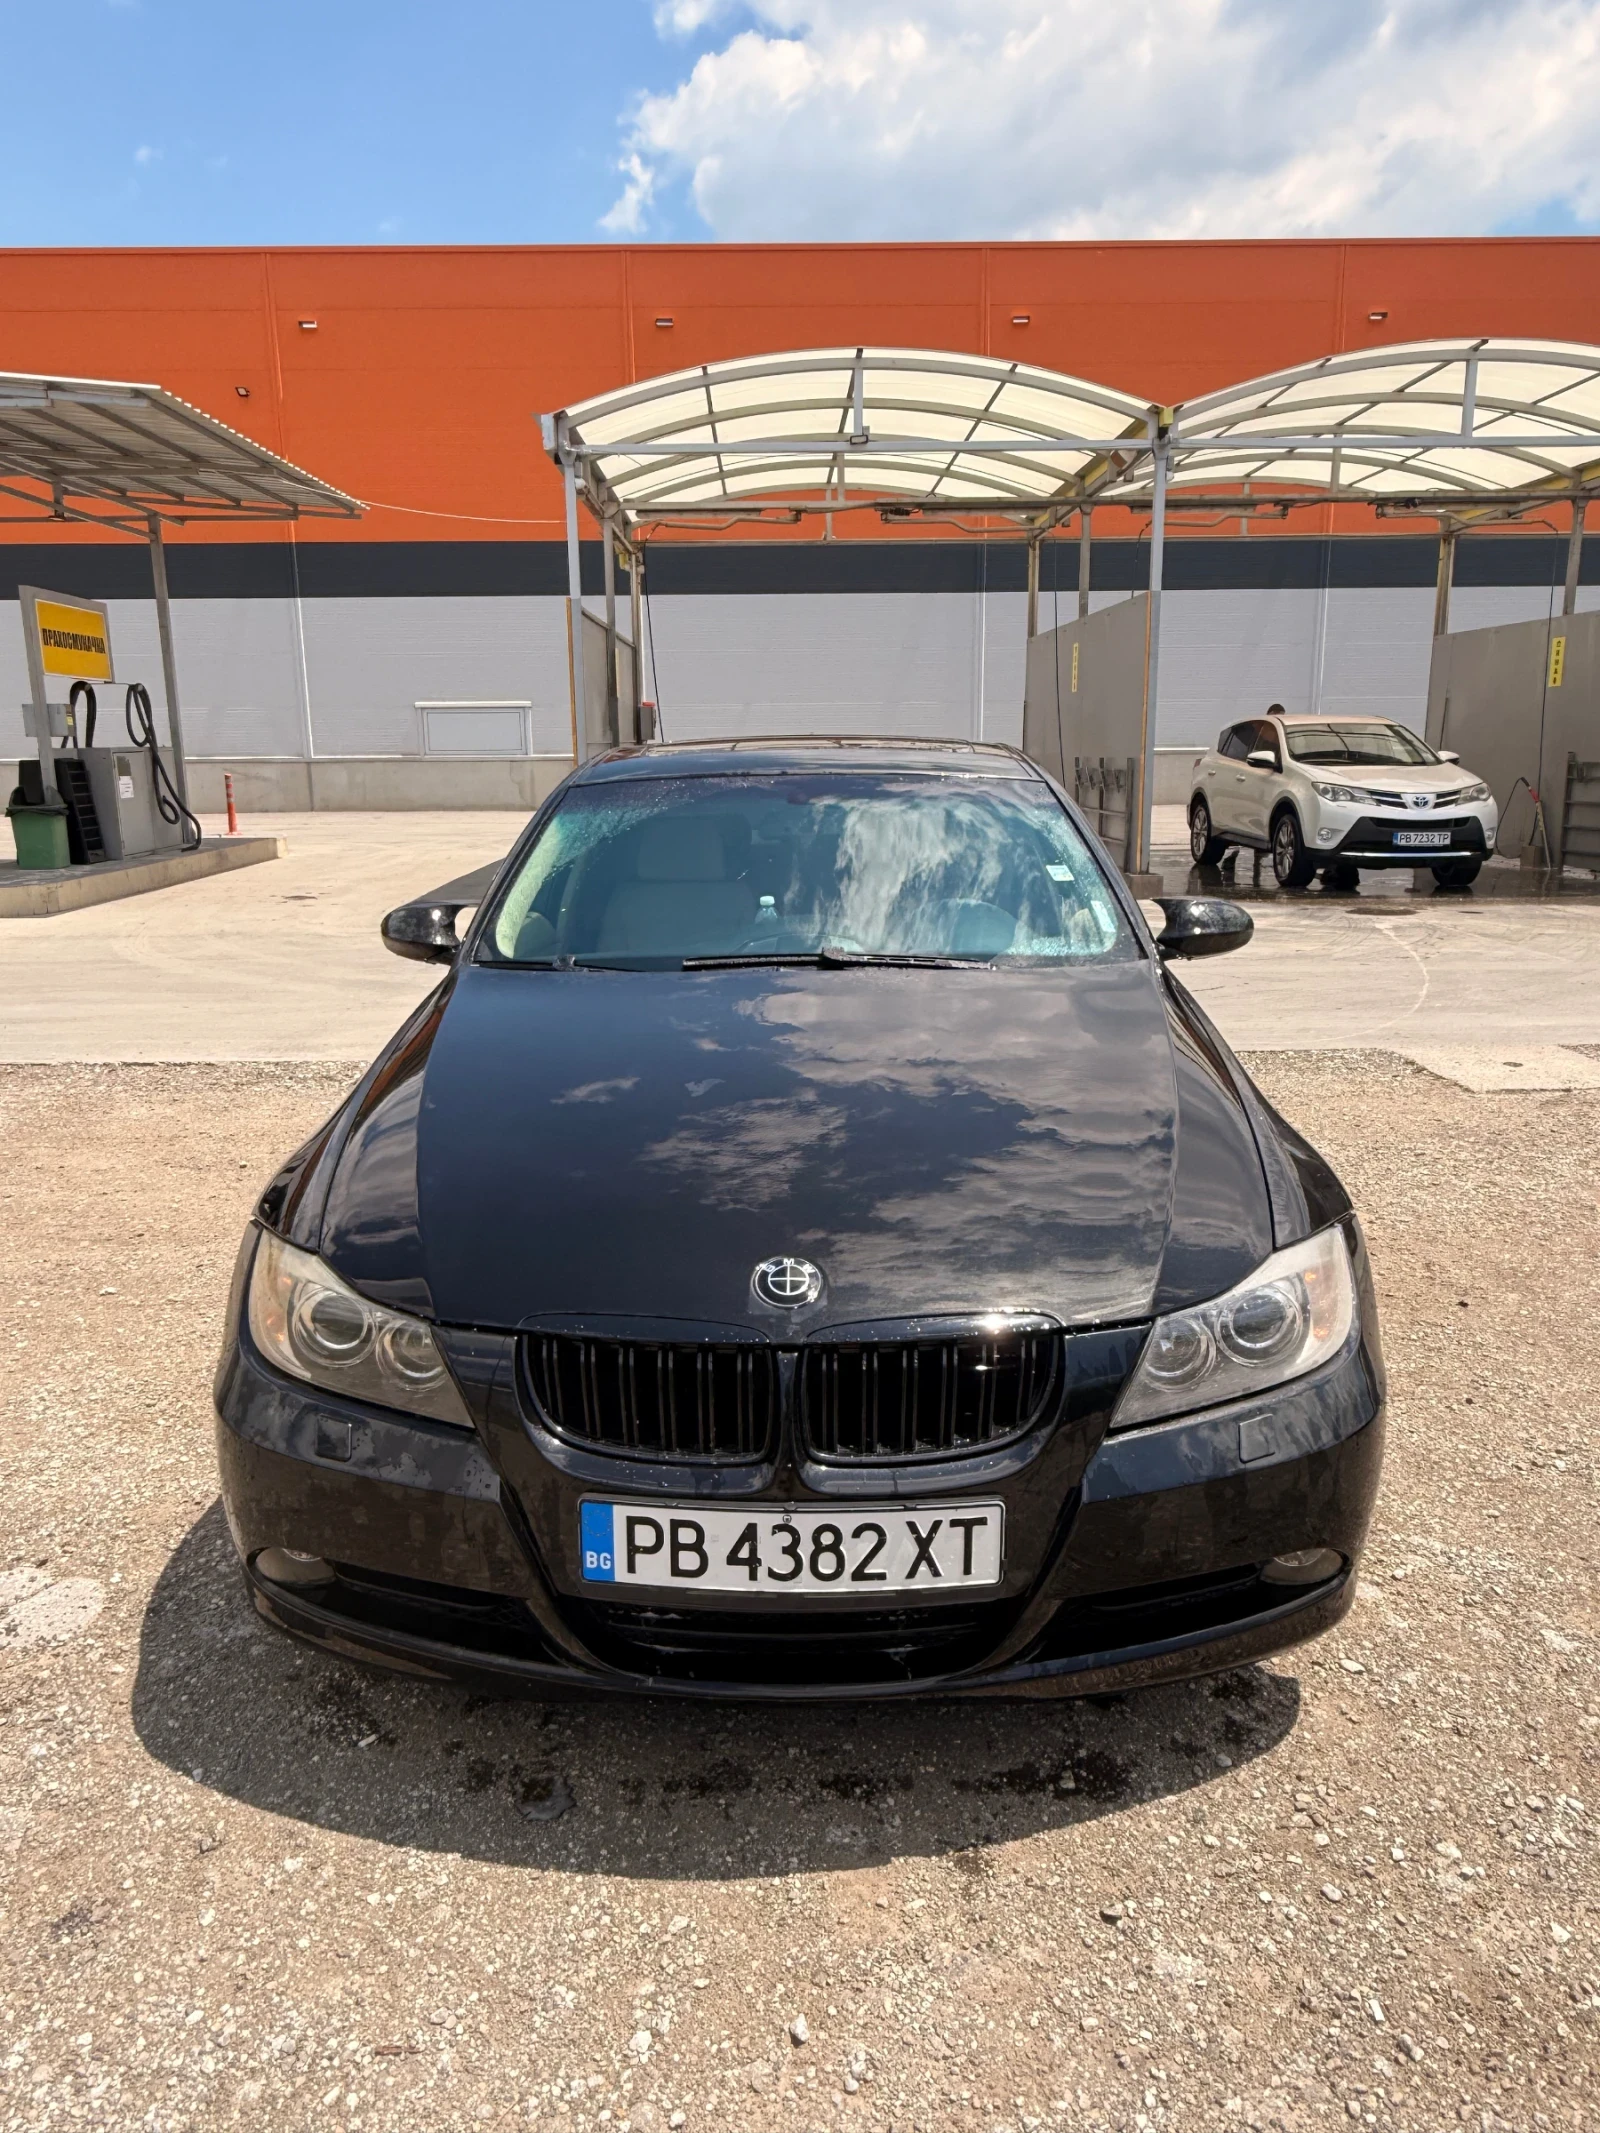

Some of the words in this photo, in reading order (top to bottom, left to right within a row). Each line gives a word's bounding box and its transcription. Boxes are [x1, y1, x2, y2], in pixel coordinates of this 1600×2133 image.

[42, 628, 106, 654] ПРАХОСМУКАЧКА
[1399, 834, 1411, 843] PB
[1413, 834, 1435, 843] 7232
[1437, 834, 1449, 843] TP
[764, 1258, 815, 1274] BMW
[626, 1515, 709, 1578] PB
[726, 1522, 888, 1581] 4382
[905, 1516, 988, 1579] XT
[586, 1551, 612, 1569] BG
